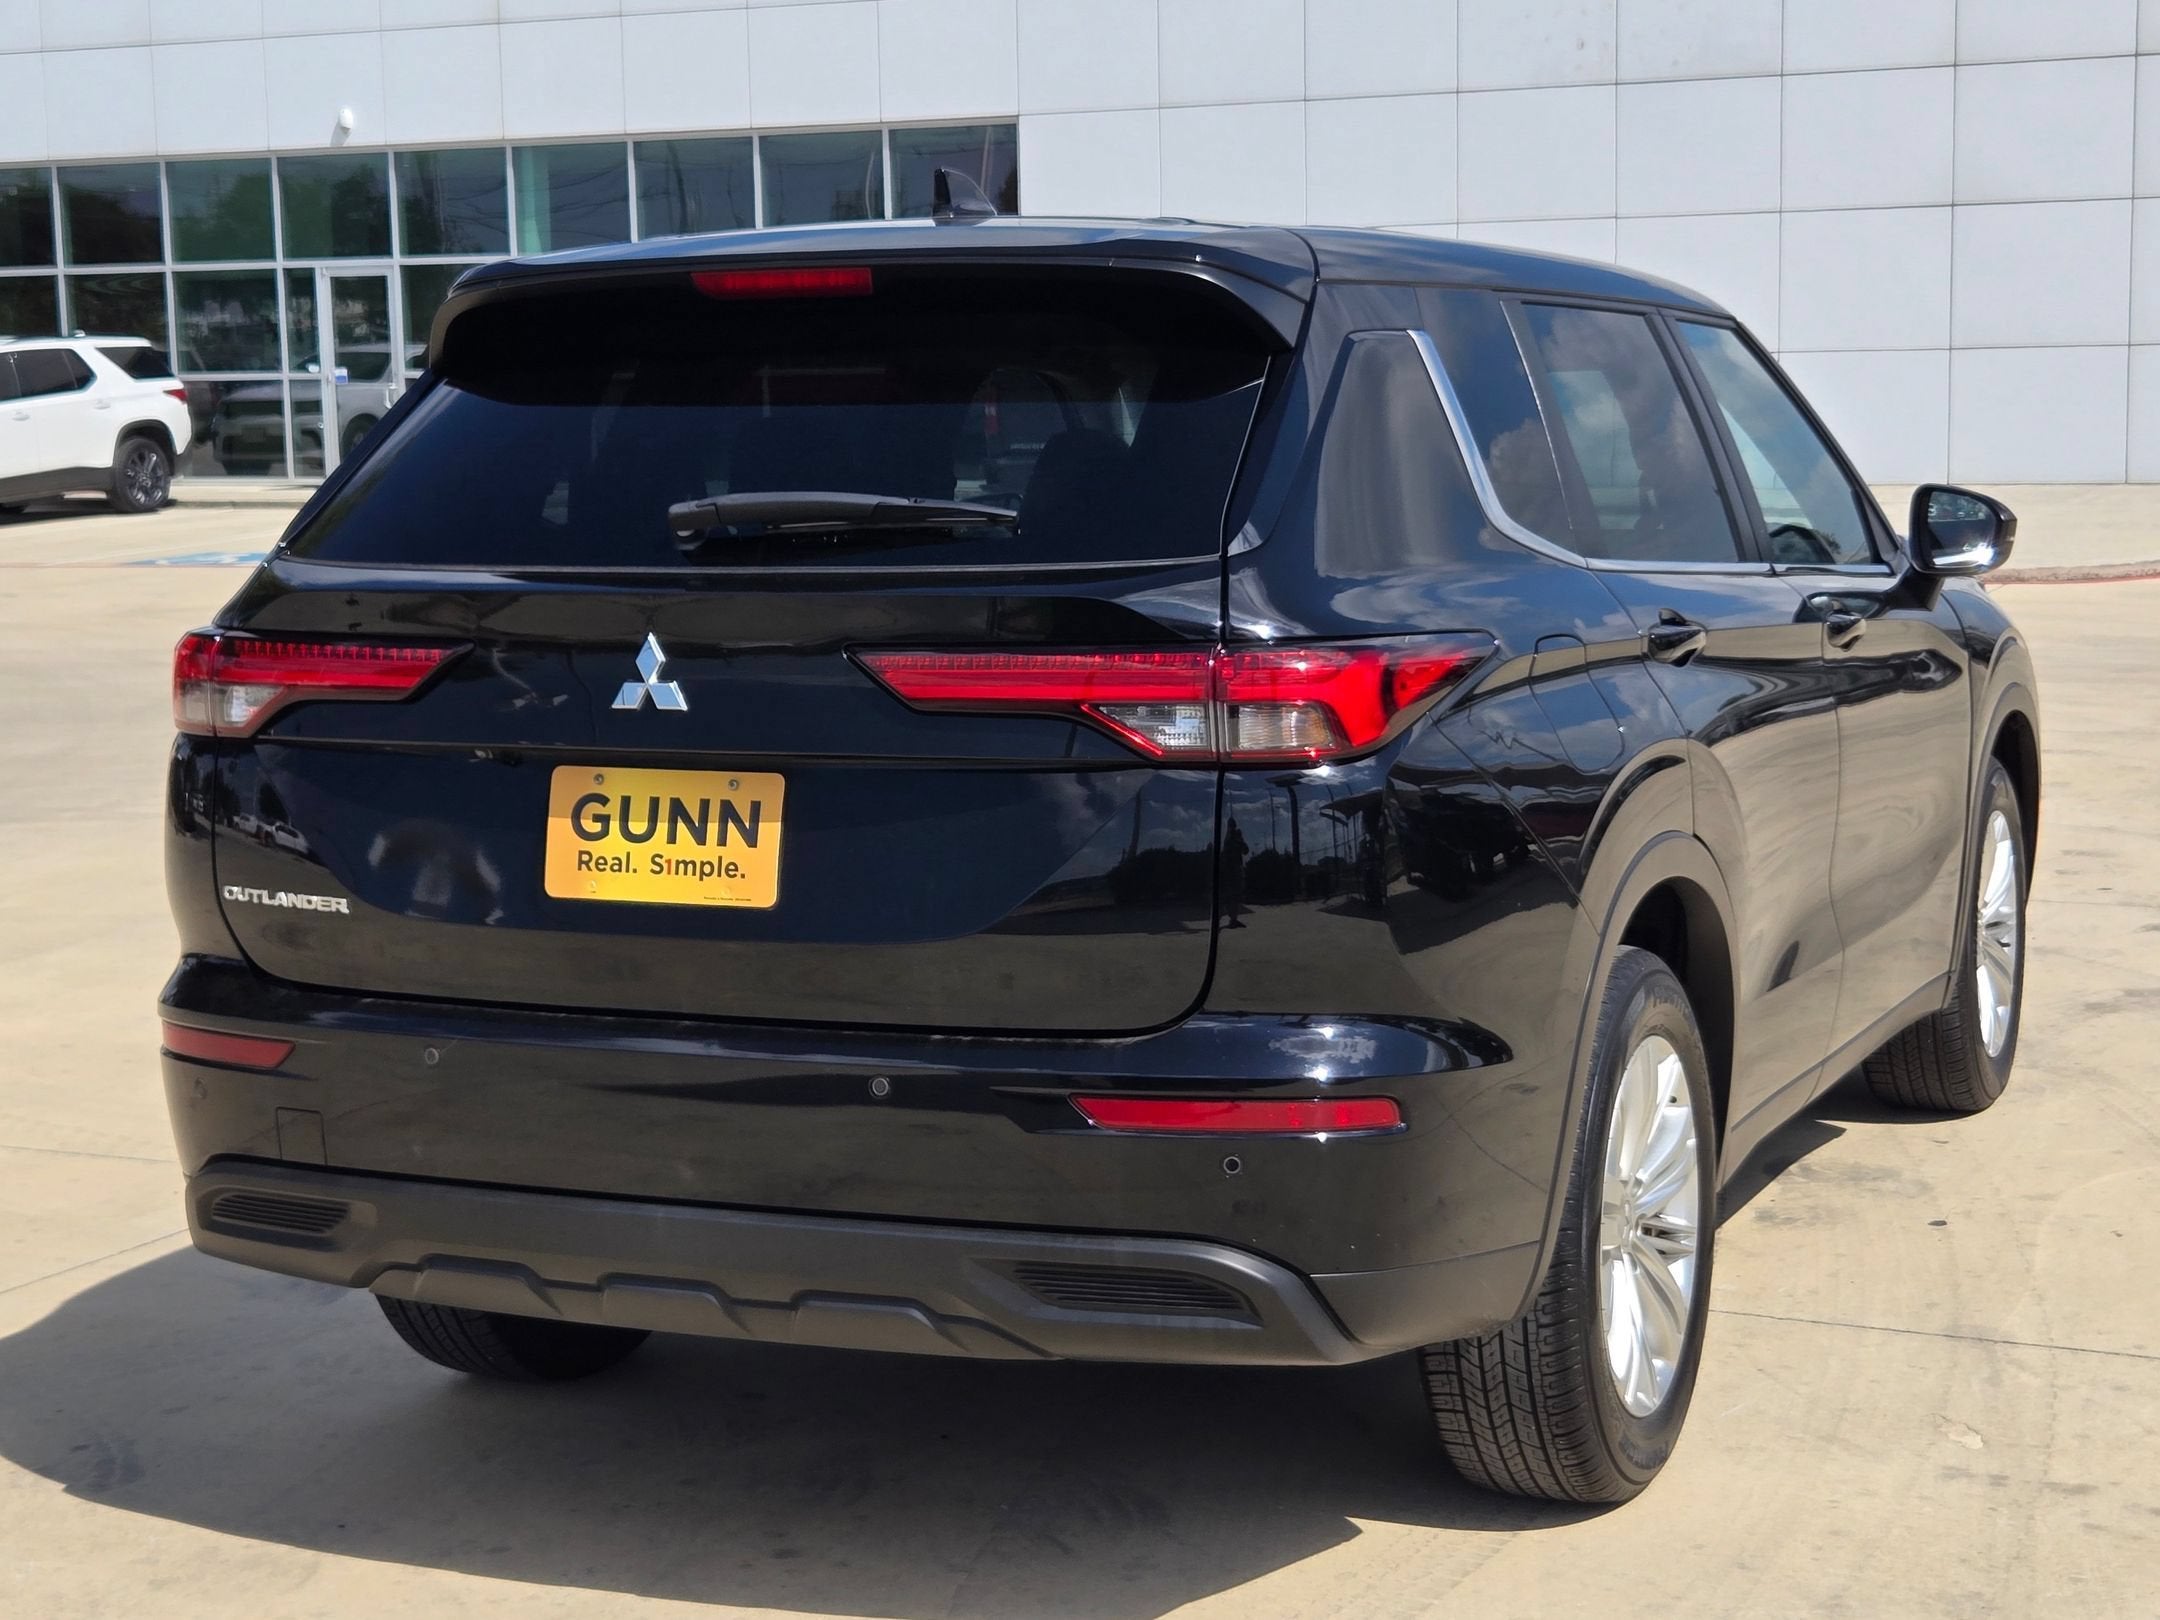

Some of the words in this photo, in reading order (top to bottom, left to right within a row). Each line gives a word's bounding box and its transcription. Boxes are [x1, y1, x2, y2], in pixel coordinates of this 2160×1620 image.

[570, 792, 762, 849] GUNN
[577, 849, 638, 874] Real.
[223, 885, 350, 914] OUTLANDER
